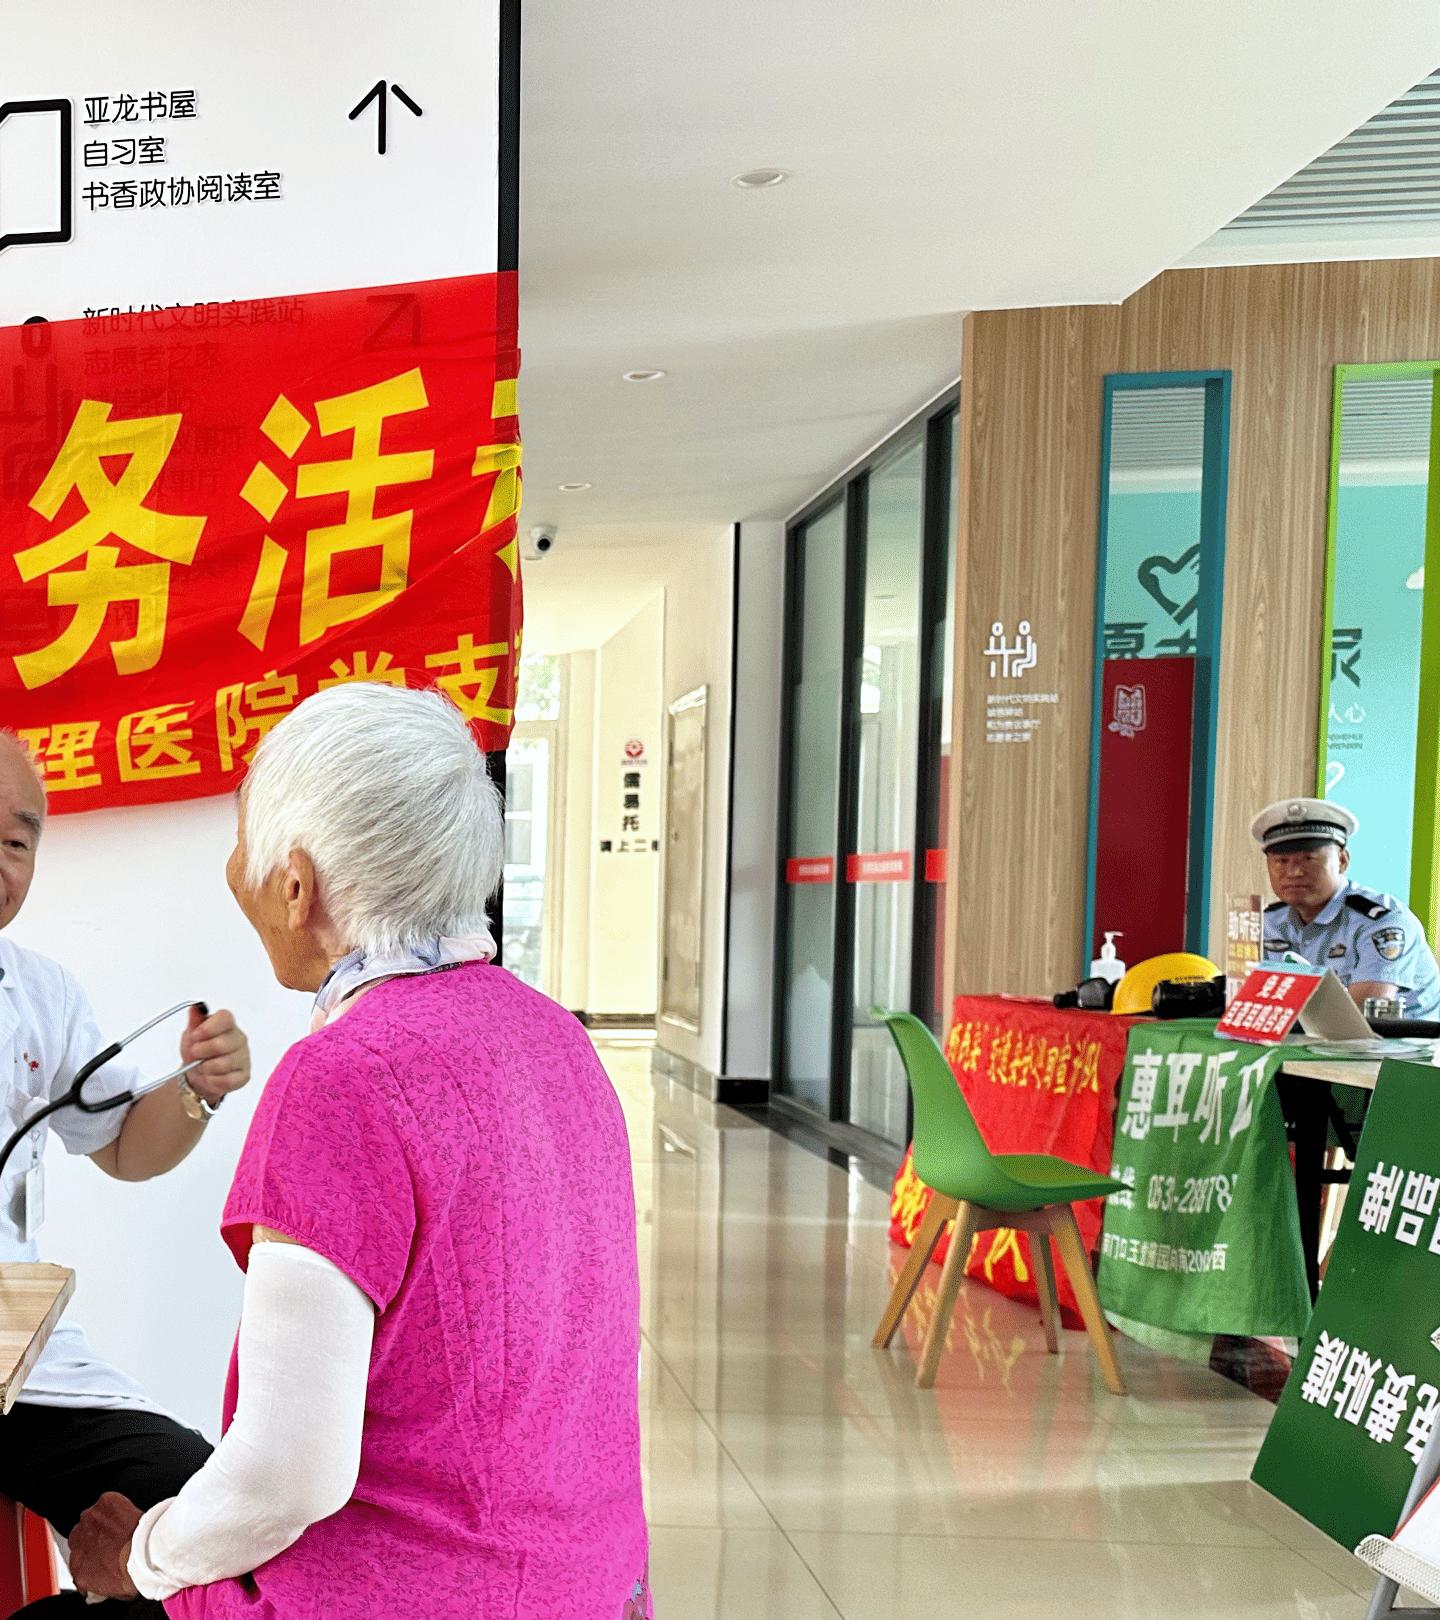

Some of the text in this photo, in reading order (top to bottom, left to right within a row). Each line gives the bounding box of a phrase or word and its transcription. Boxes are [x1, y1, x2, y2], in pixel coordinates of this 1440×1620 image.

[84, 89, 197, 125] 亚龙书屋
[83, 136, 165, 167] 自习室
[82, 170, 282, 211] 书香政协阅读室
[1300, 1330, 1438, 1465] 免费贴膜
